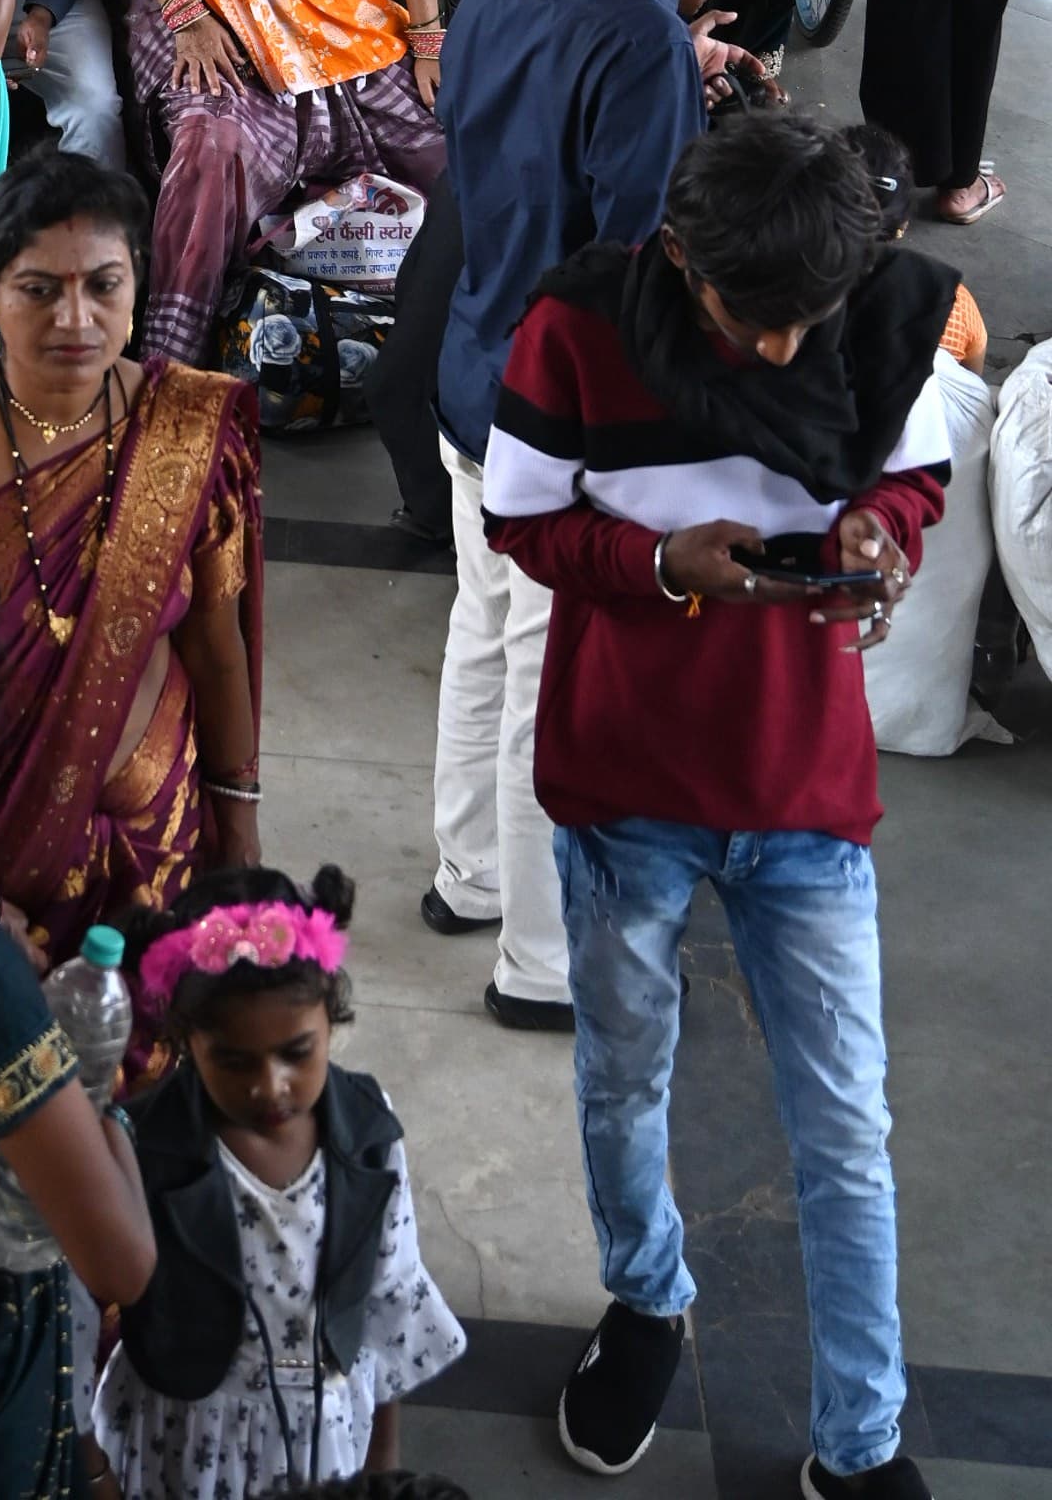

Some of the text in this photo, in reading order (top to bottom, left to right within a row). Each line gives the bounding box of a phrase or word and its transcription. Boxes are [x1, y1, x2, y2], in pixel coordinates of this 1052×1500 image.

[339, 220, 375, 241] फैंसी
[378, 221, 414, 240] स्टोर
[307, 248, 328, 262] प्रकार
[330, 248, 339, 261] के
[340, 264, 368, 275] आयटम
